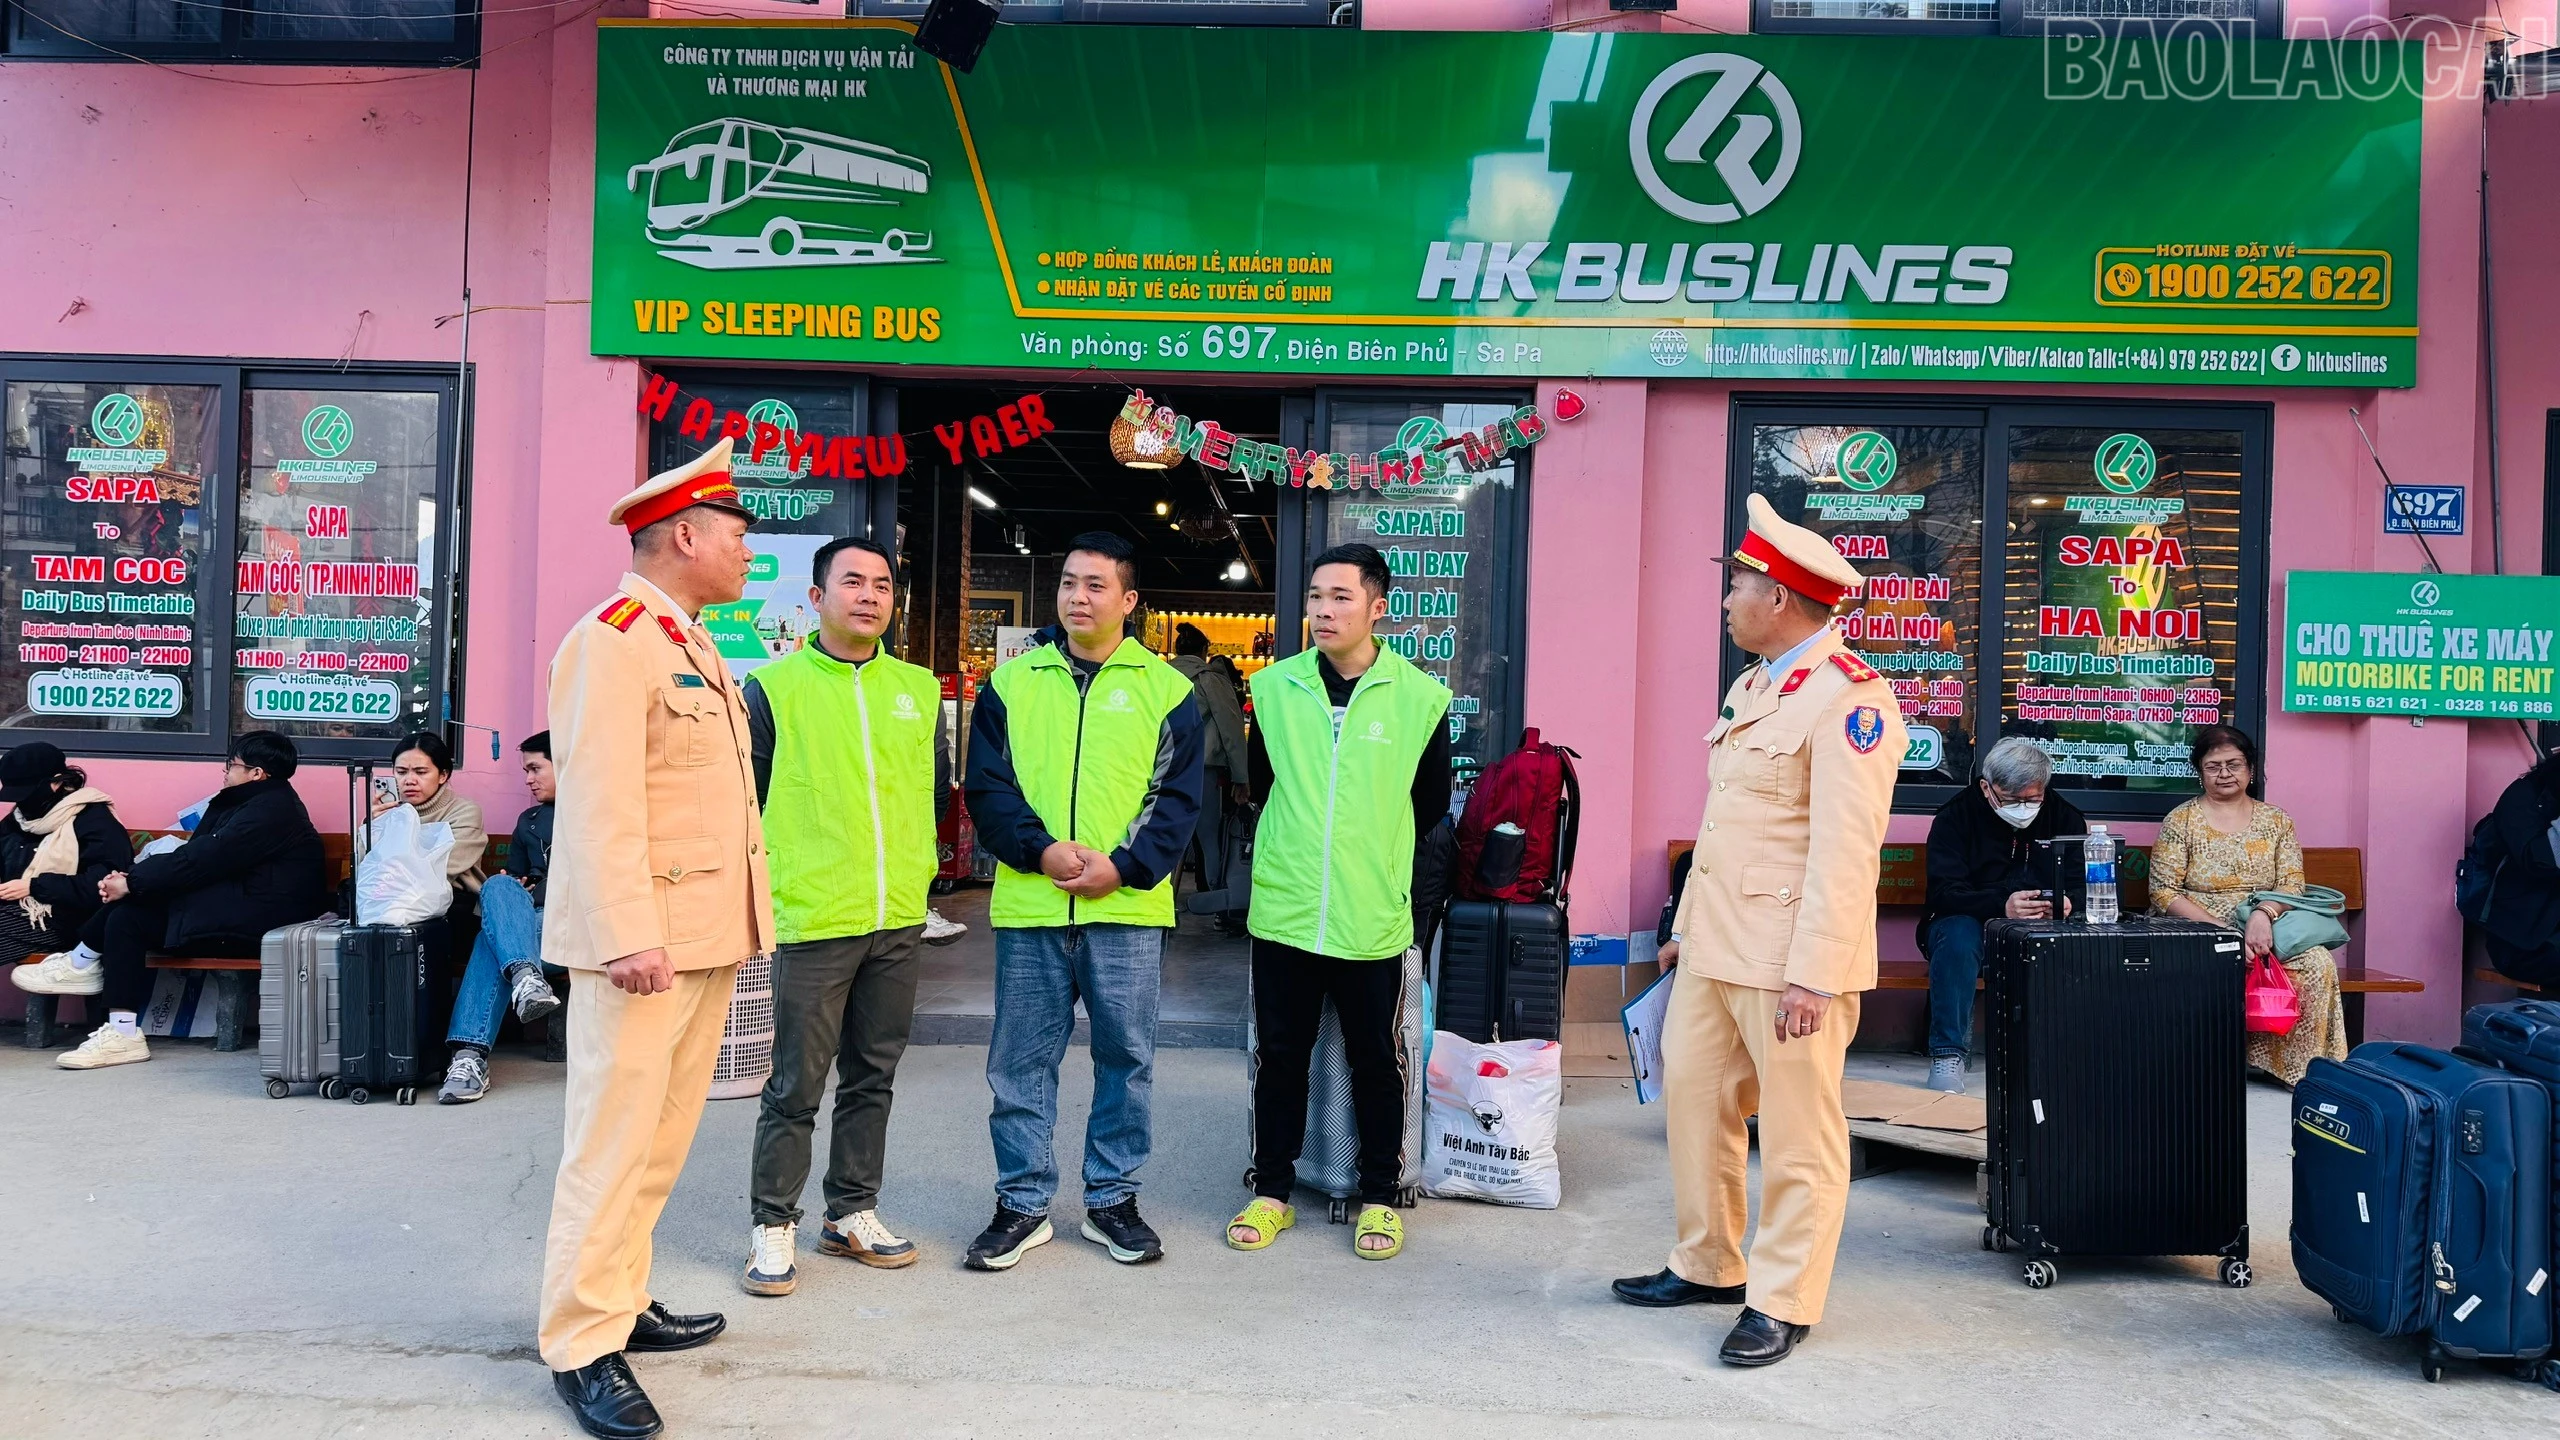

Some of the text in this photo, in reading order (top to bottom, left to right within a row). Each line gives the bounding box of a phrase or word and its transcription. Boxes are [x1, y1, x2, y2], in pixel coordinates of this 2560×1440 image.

[663, 43, 915, 72] CÔNG TY TNHH DỊCH VỤ VẬN TẢI
[707, 73, 867, 101] VÀ THƯƠNG MẠI HK
[1055, 250, 1088, 272] HỢP
[1094, 246, 1138, 270] ĐỒNG
[1143, 249, 1197, 271] KHÁCH
[1228, 249, 1283, 273] KHÁCH
[1287, 251, 1332, 274] ĐOÀN
[2156, 241, 2297, 263] HOTLINE ĐẶT VÉ
[1416, 241, 2013, 305] HK BUSLINES
[2144, 263, 2381, 301] 1900 252 622
[1054, 276, 1332, 306] NHẬN ĐẶT VÉ CÁC TUYẾN CỐ ĐỊNH
[634, 300, 942, 342] VIP SLEEPING BUS
[1020, 325, 1543, 364] Văn phòng: Số 697, Điện Biên Phủ Sa Pa
[1704, 342, 1855, 368] http://hkbuslines.vn/
[2169, 348, 2195, 370] 979
[2200, 348, 2227, 371] 252
[2307, 351, 2388, 373] hkbuslines
[637, 373, 811, 472] HAPPY
[933, 393, 1055, 465] YAER
[1168, 414, 1318, 488] MERRY
[67, 477, 160, 502] SAPA
[777, 496, 805, 520] TO
[2392, 492, 2458, 516] 697
[94, 522, 121, 540] To
[307, 505, 349, 539] SAPA
[1376, 510, 1436, 536] SAPA
[1440, 511, 1465, 537] ĐI
[2080, 514, 2146, 523] LIMOUSINE
[2421, 517, 2439, 529] BIÊN
[1832, 535, 1889, 559] SAPA
[2059, 535, 2186, 567] SAPA
[32, 556, 187, 584] TAM COC
[269, 551, 302, 595] CỐC
[305, 563, 373, 598] (TP.NINH
[375, 557, 420, 600] BÌNH)
[1424, 551, 1469, 578] BAY
[1869, 573, 1950, 604] NỘI BÀI
[2108, 576, 2137, 595] To
[22, 590, 194, 615] Daily Bus Timetable
[734, 610, 750, 621] IN
[1418, 587, 1457, 618] BÀI
[2410, 609, 2454, 617] BUSLINES
[22, 622, 161, 640] Departure from Tam Coc (Ninh
[315, 615, 417, 643] hàng ngày SaPa:
[1867, 612, 1941, 645] HÀ NỘI
[2039, 606, 2201, 641] HA NOI
[1423, 625, 1456, 661] CỔ
[2296, 619, 2554, 662] CHO THUÊ XE MÁY
[20, 645, 191, 665] 11H00 21H00 22H00
[237, 650, 409, 672] 11H00 21H00 22H00
[1930, 651, 1964, 670] SaPa:
[2027, 651, 2215, 677] Daily Bus Timetable
[72, 669, 113, 681] Hotline
[290, 675, 332, 687] Hotline
[2296, 661, 2555, 694] MOTORBIKE FOR RENT
[38, 686, 173, 709] 1900 252 622
[254, 689, 391, 714] 1900 252 622
[1930, 681, 1963, 697] 13H00
[2017, 684, 2221, 704] Departure from Hanoi: 06H00 23H59
[1928, 701, 1963, 717] 23H00
[2019, 704, 2219, 724] Departure from Sapa: 07H30 23H00
[2295, 694, 2553, 714] ĐT: 0815 621 621 0328 146 886
[1443, 1132, 1530, 1161] Việt Anh Tây Bắc
